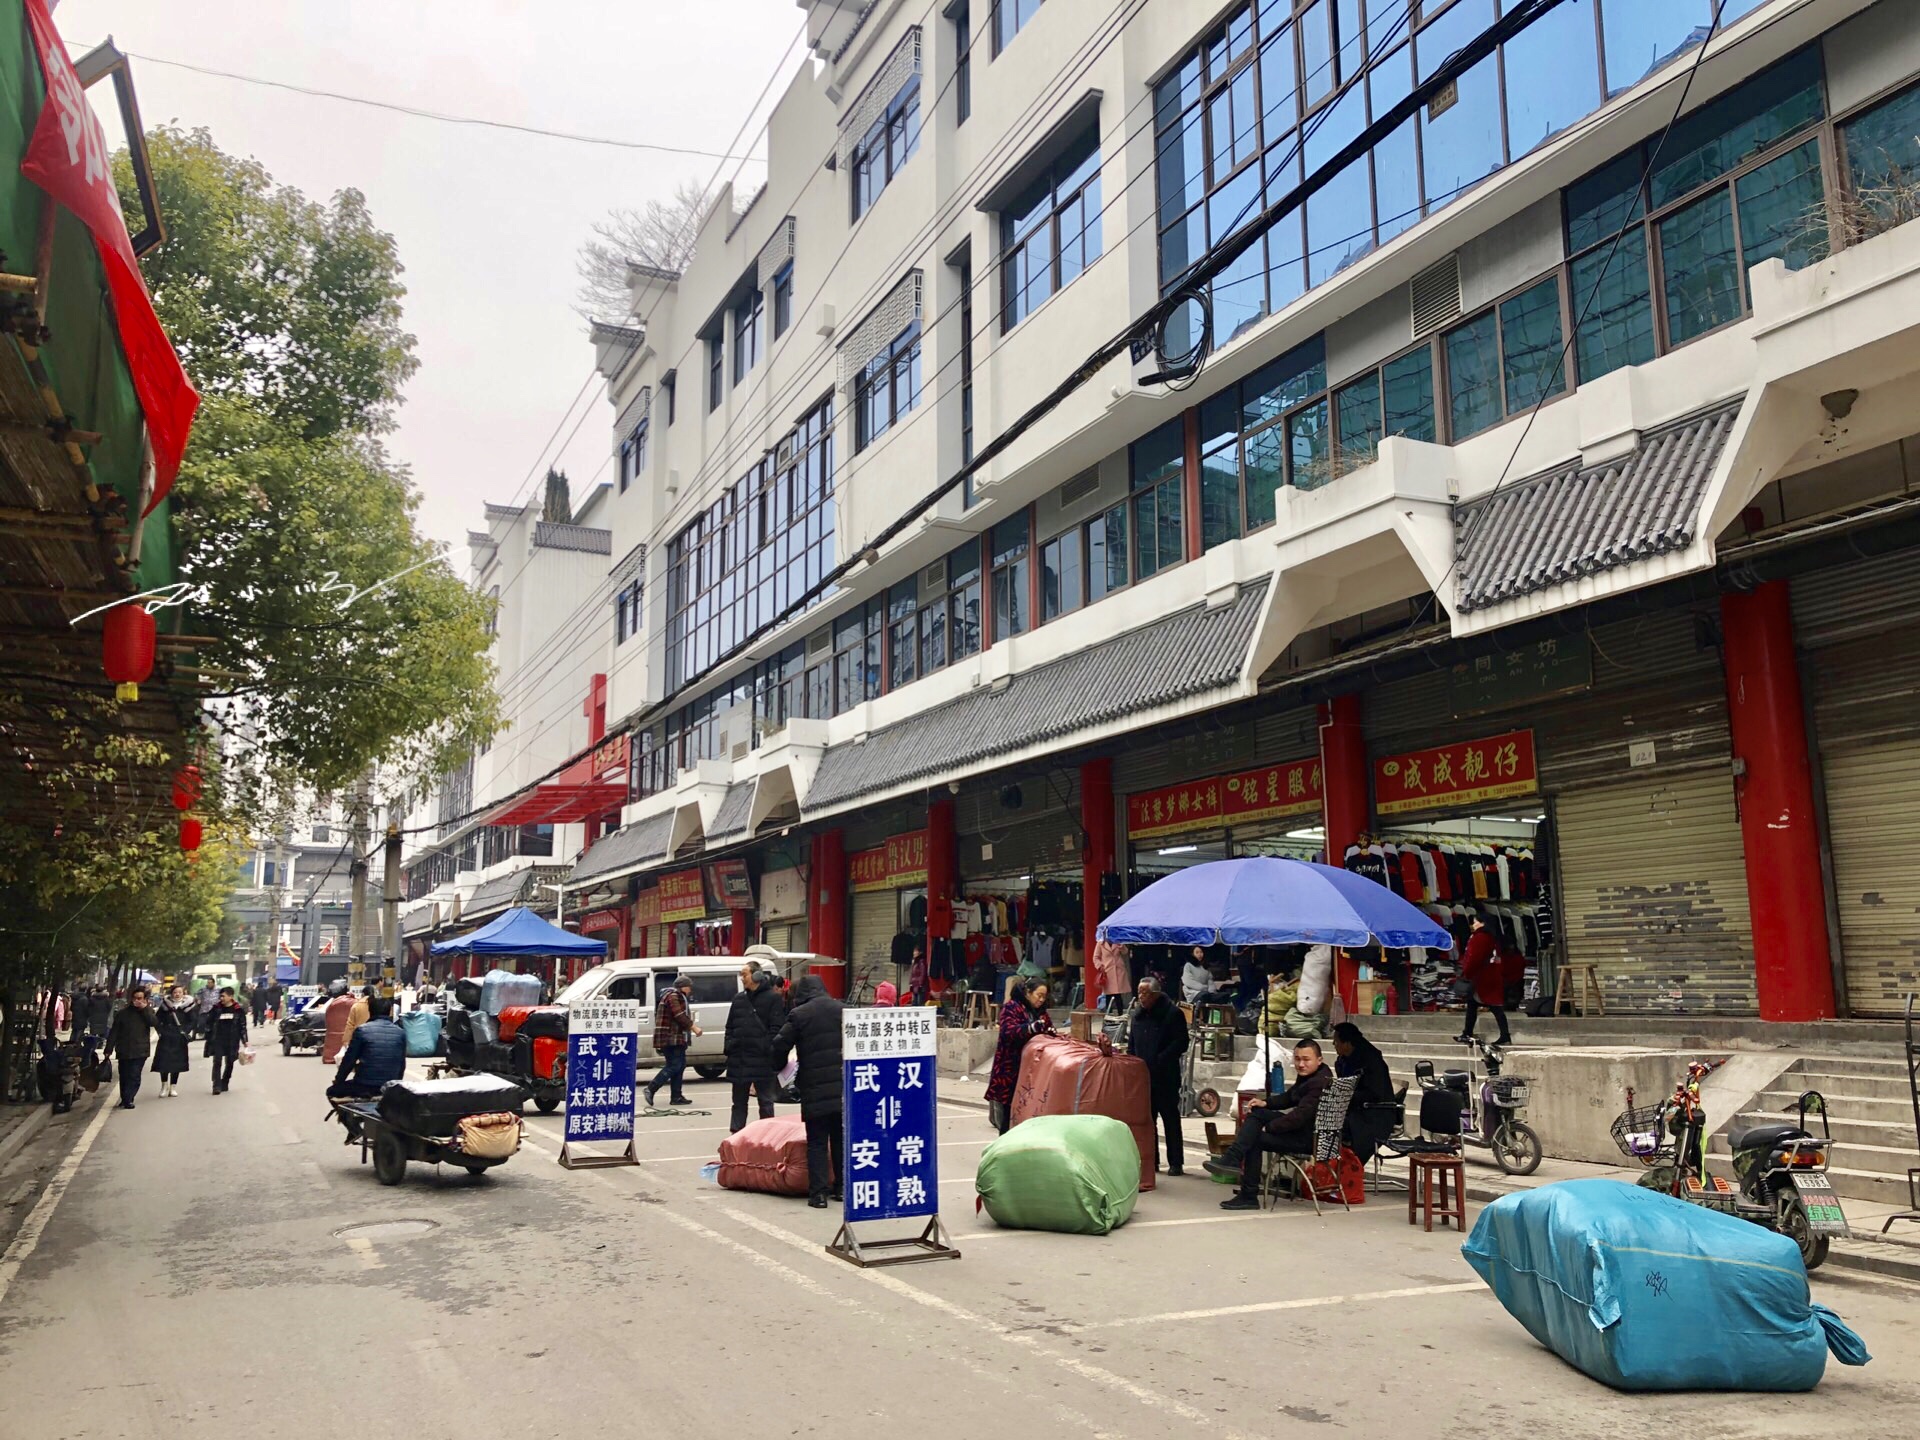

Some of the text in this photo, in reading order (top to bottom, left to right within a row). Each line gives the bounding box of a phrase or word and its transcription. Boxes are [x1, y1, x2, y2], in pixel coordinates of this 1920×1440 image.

[1403, 741, 1519, 793] 成成靓仔
[572, 1008, 637, 1019] 物流服务中转区
[585, 1020, 624, 1029] 保安物流
[844, 1020, 931, 1038] 物流服务中转区
[577, 1035, 630, 1056] 武汉
[855, 1038, 921, 1053] 恒鑫达物流
[853, 1062, 924, 1093] 武汉
